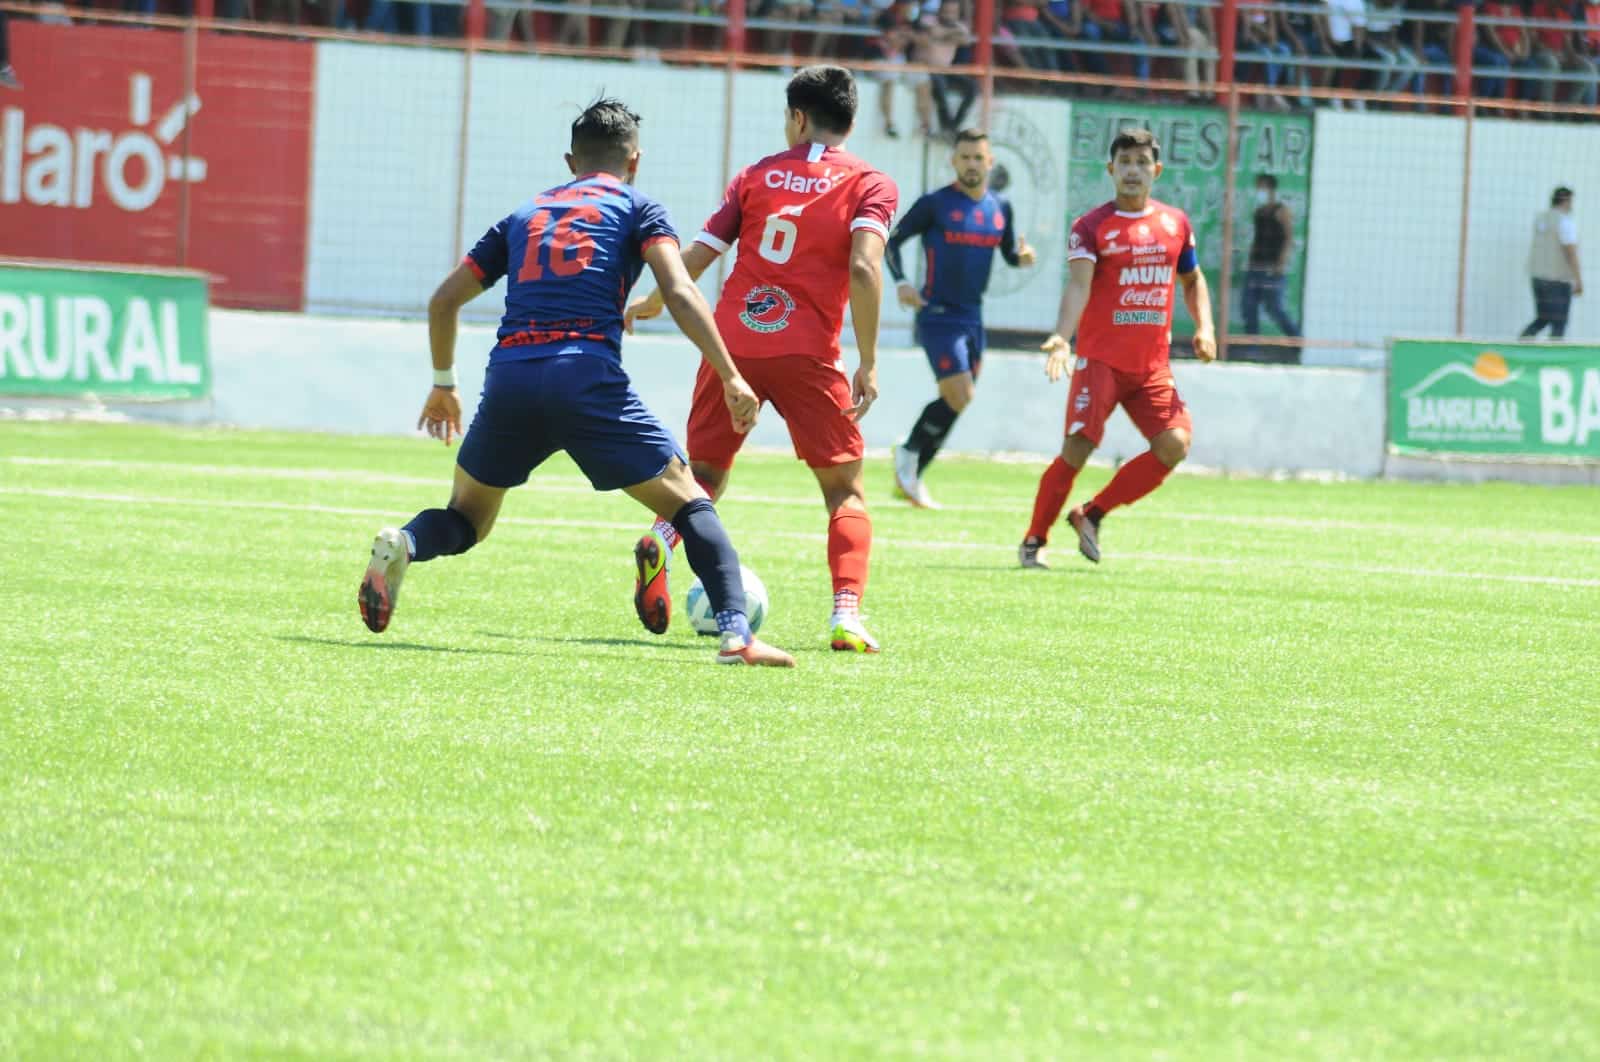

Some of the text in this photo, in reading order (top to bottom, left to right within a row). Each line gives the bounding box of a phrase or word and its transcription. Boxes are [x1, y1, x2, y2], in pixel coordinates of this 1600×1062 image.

[764, 169, 832, 194] Claro
[517, 204, 602, 283] 16
[758, 205, 804, 265] 6
[1407, 397, 1524, 431] BANRURAL
